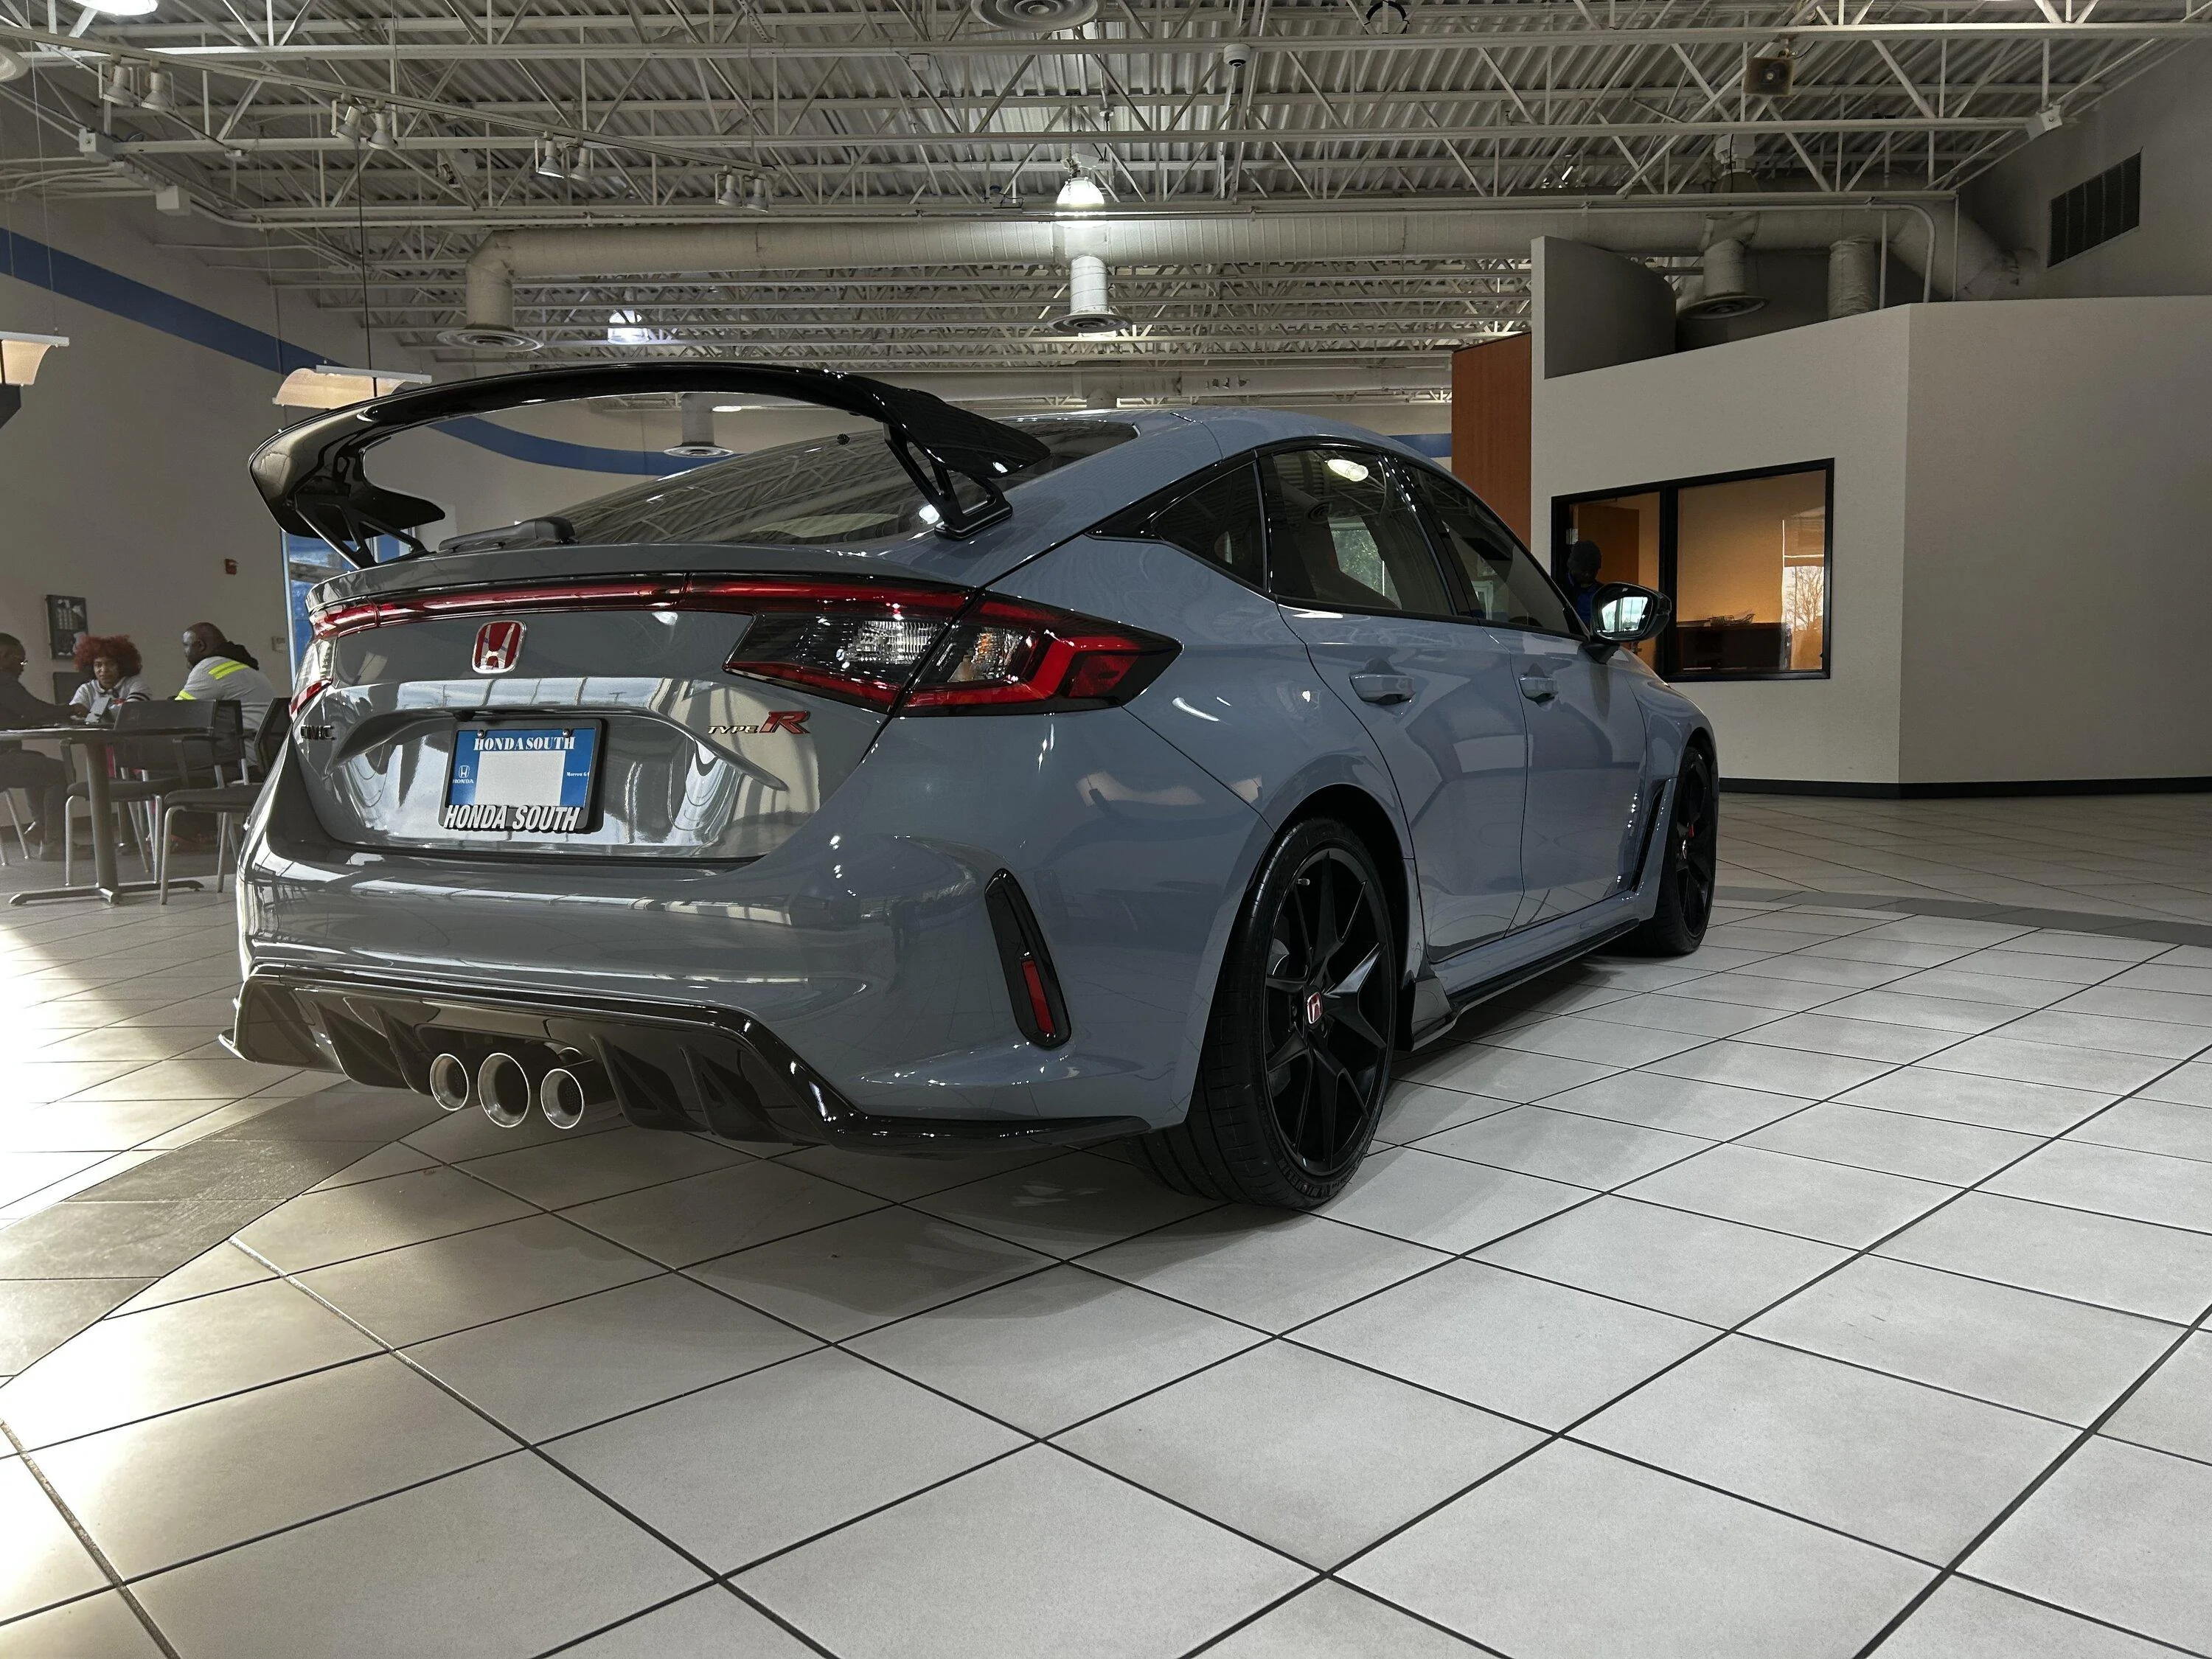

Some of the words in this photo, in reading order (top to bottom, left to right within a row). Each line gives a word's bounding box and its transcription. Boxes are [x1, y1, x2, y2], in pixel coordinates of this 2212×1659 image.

[708, 726, 759, 734] TYPE
[759, 710, 810, 734] R
[444, 804, 507, 829] HONDA
[512, 805, 580, 832] SOUTH
